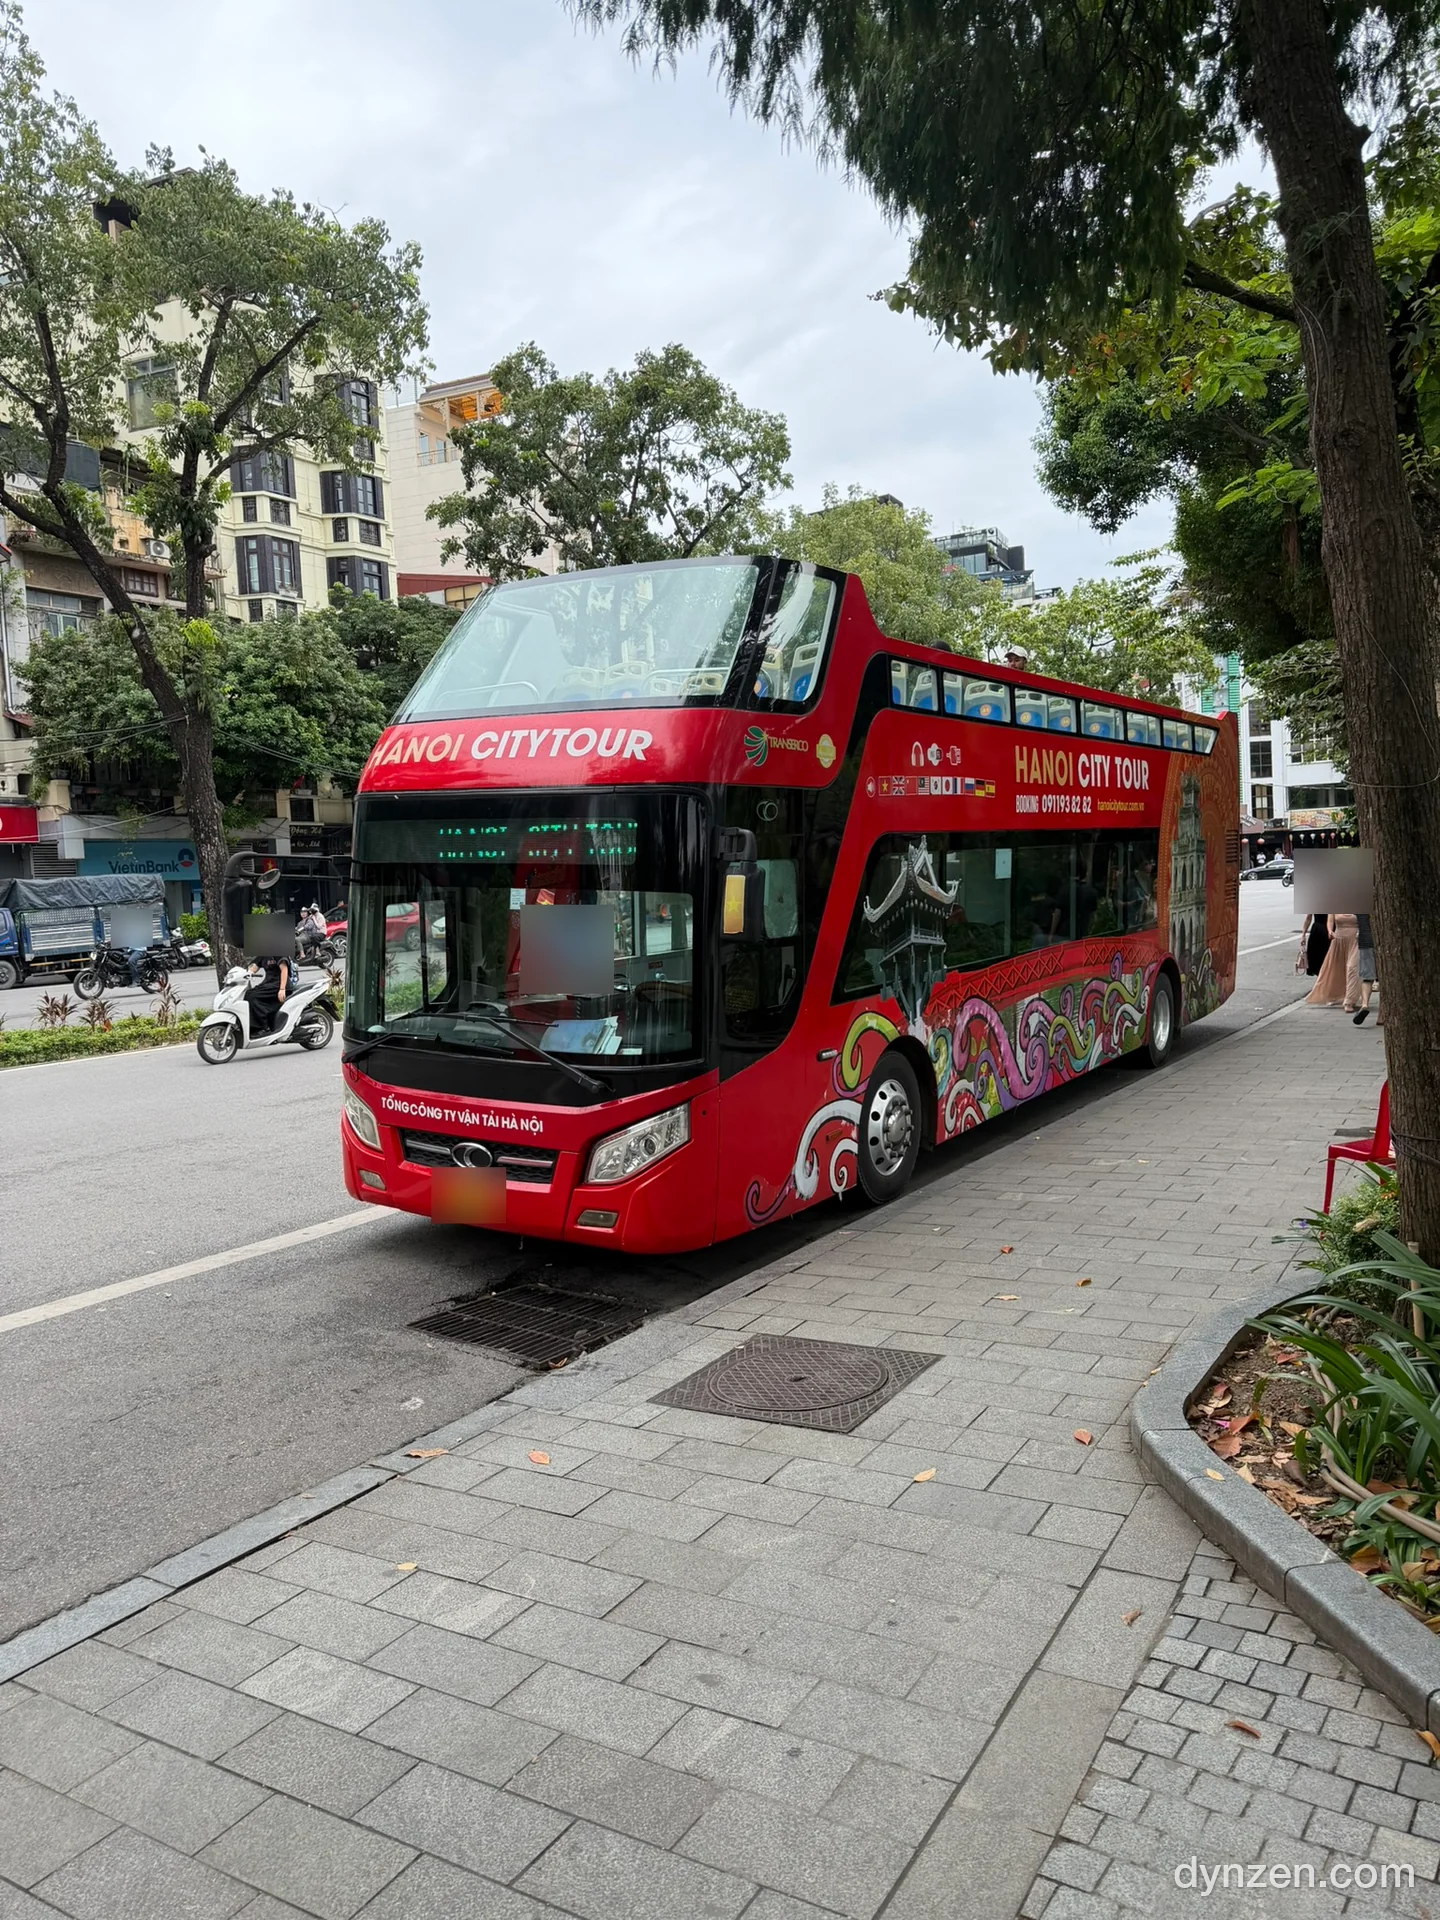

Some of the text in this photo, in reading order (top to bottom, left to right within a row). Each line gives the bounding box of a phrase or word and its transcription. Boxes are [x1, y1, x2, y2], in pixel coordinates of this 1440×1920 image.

[367, 727, 653, 769] HANOI CITYTOUR
[768, 736, 809, 752] TRANSERCO
[1015, 745, 1149, 790] HANOI CITY TOUR
[1015, 794, 1039, 813] BOOKING
[108, 860, 180, 874] VietinBank
[381, 1093, 543, 1136] TỔNG CÔNG TY VẬN TẢI HÀ NỘI
